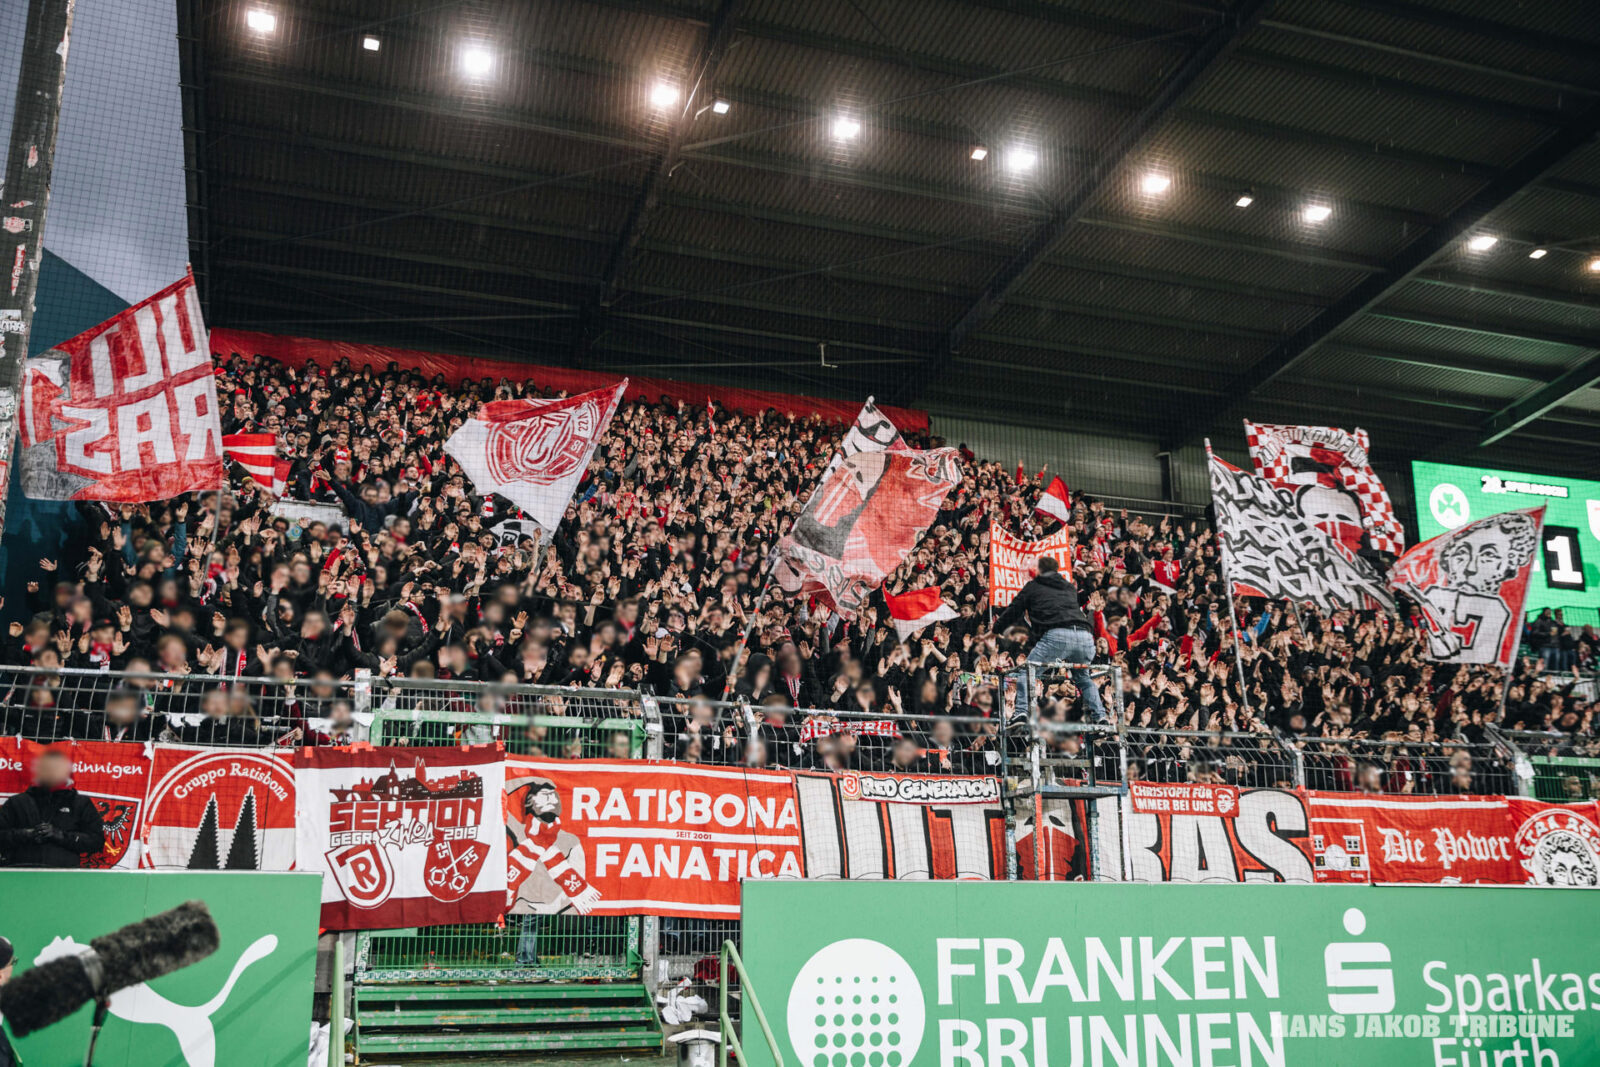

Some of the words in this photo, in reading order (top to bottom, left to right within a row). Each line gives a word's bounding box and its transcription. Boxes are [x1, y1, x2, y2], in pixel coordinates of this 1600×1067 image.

[1546, 536, 1583, 584] 1
[0, 758, 23, 771] Die
[72, 761, 143, 779] sinnigen
[173, 767, 226, 799] Gruppo
[229, 762, 288, 801] Ratisbona
[860, 776, 899, 798] RED
[898, 778, 998, 800] GENERATION
[1133, 785, 1191, 798] CHRISTOPH
[1192, 786, 1213, 799] FÜR
[571, 786, 798, 829] RATISBONA
[1135, 798, 1170, 810] IMMER
[1172, 799, 1190, 811] BEI
[1192, 800, 1214, 812] UNS
[444, 825, 479, 841] 2019
[676, 831, 691, 839] SEIT
[693, 832, 712, 840] 2001
[1377, 826, 1427, 863] Die
[1431, 827, 1512, 869] Power
[461, 849, 480, 868] 25
[596, 843, 804, 882] FANATICA
[937, 936, 1280, 1005] FRANKEN
[938, 1011, 1286, 1067] BRUNNEN
